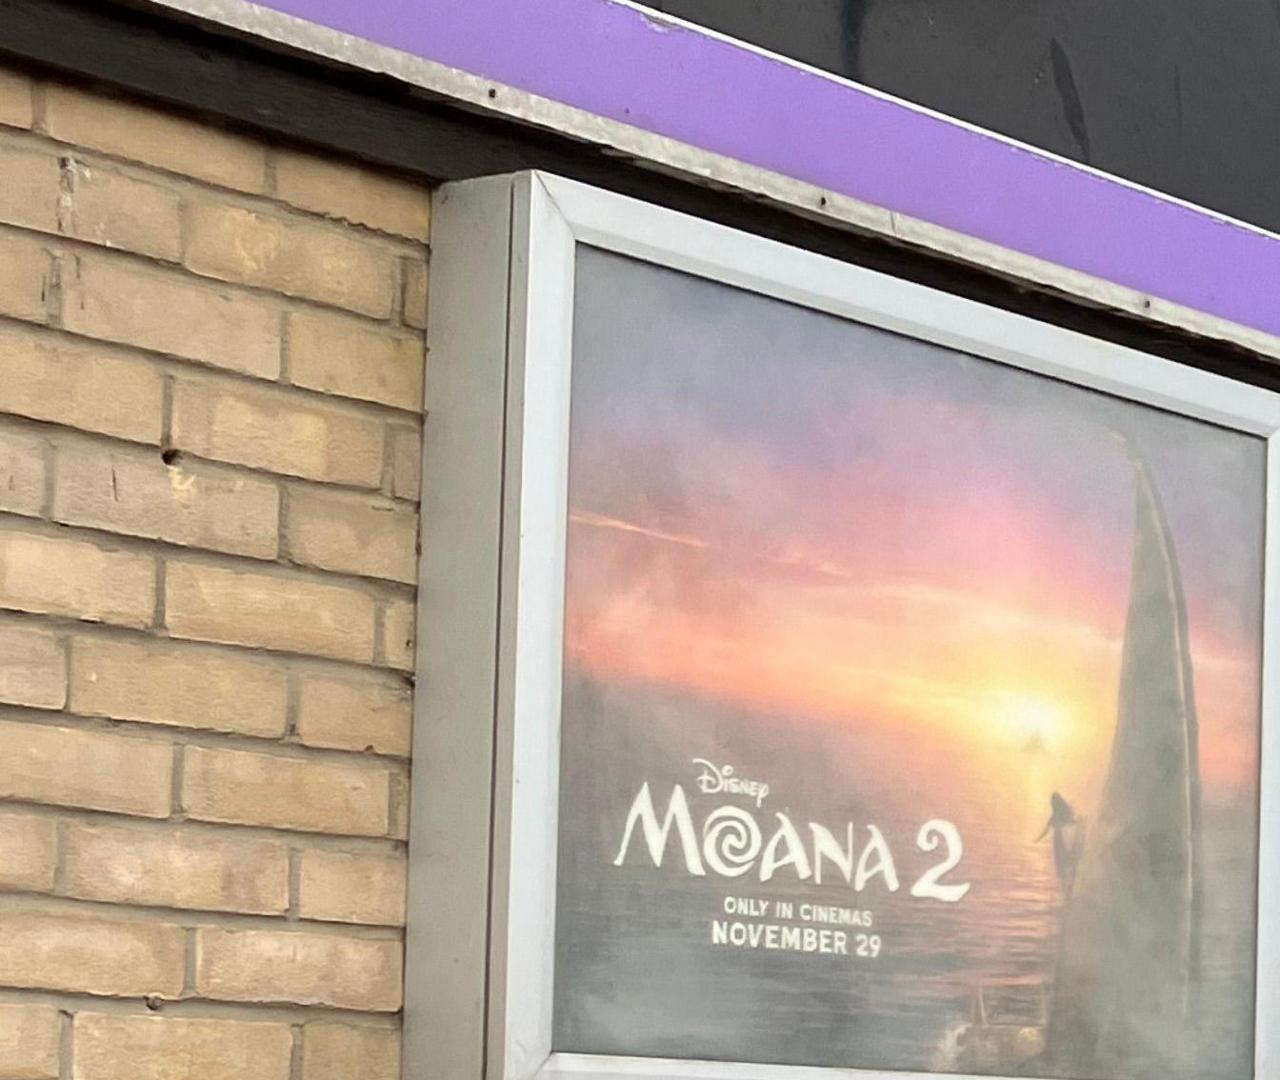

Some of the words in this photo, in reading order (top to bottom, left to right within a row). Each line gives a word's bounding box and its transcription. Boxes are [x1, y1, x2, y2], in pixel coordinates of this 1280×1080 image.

[693, 758, 769, 807] Disney
[613, 781, 899, 892] MOANA
[910, 819, 971, 901] 2
[724, 896, 769, 918] ONLY
[775, 900, 793, 919] IN
[800, 903, 873, 927] CINEMAS
[712, 920, 847, 954] NOVEMBER
[856, 934, 881, 957] 29
